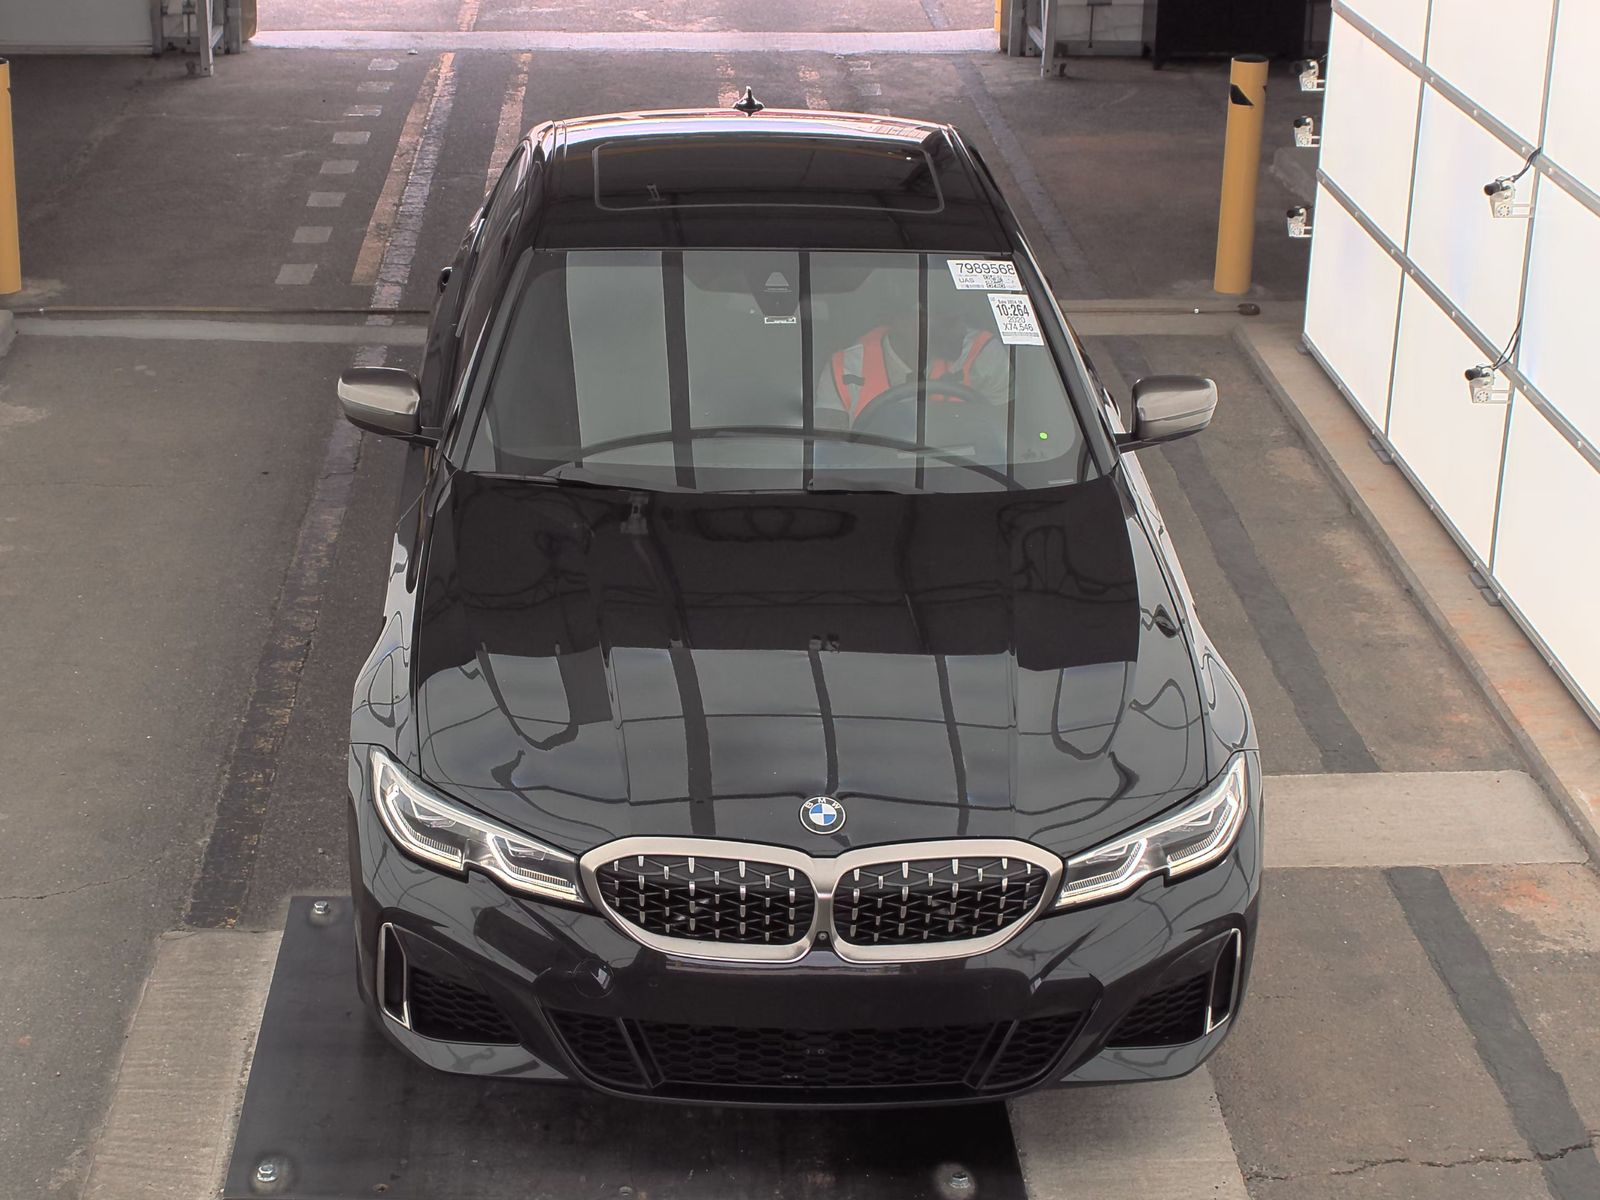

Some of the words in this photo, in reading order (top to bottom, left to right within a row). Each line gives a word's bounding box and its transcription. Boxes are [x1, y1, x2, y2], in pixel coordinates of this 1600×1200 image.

[955, 263, 1016, 275] 7989568
[995, 304, 1030, 317] 10:264
[804, 797, 841, 809] BMW
